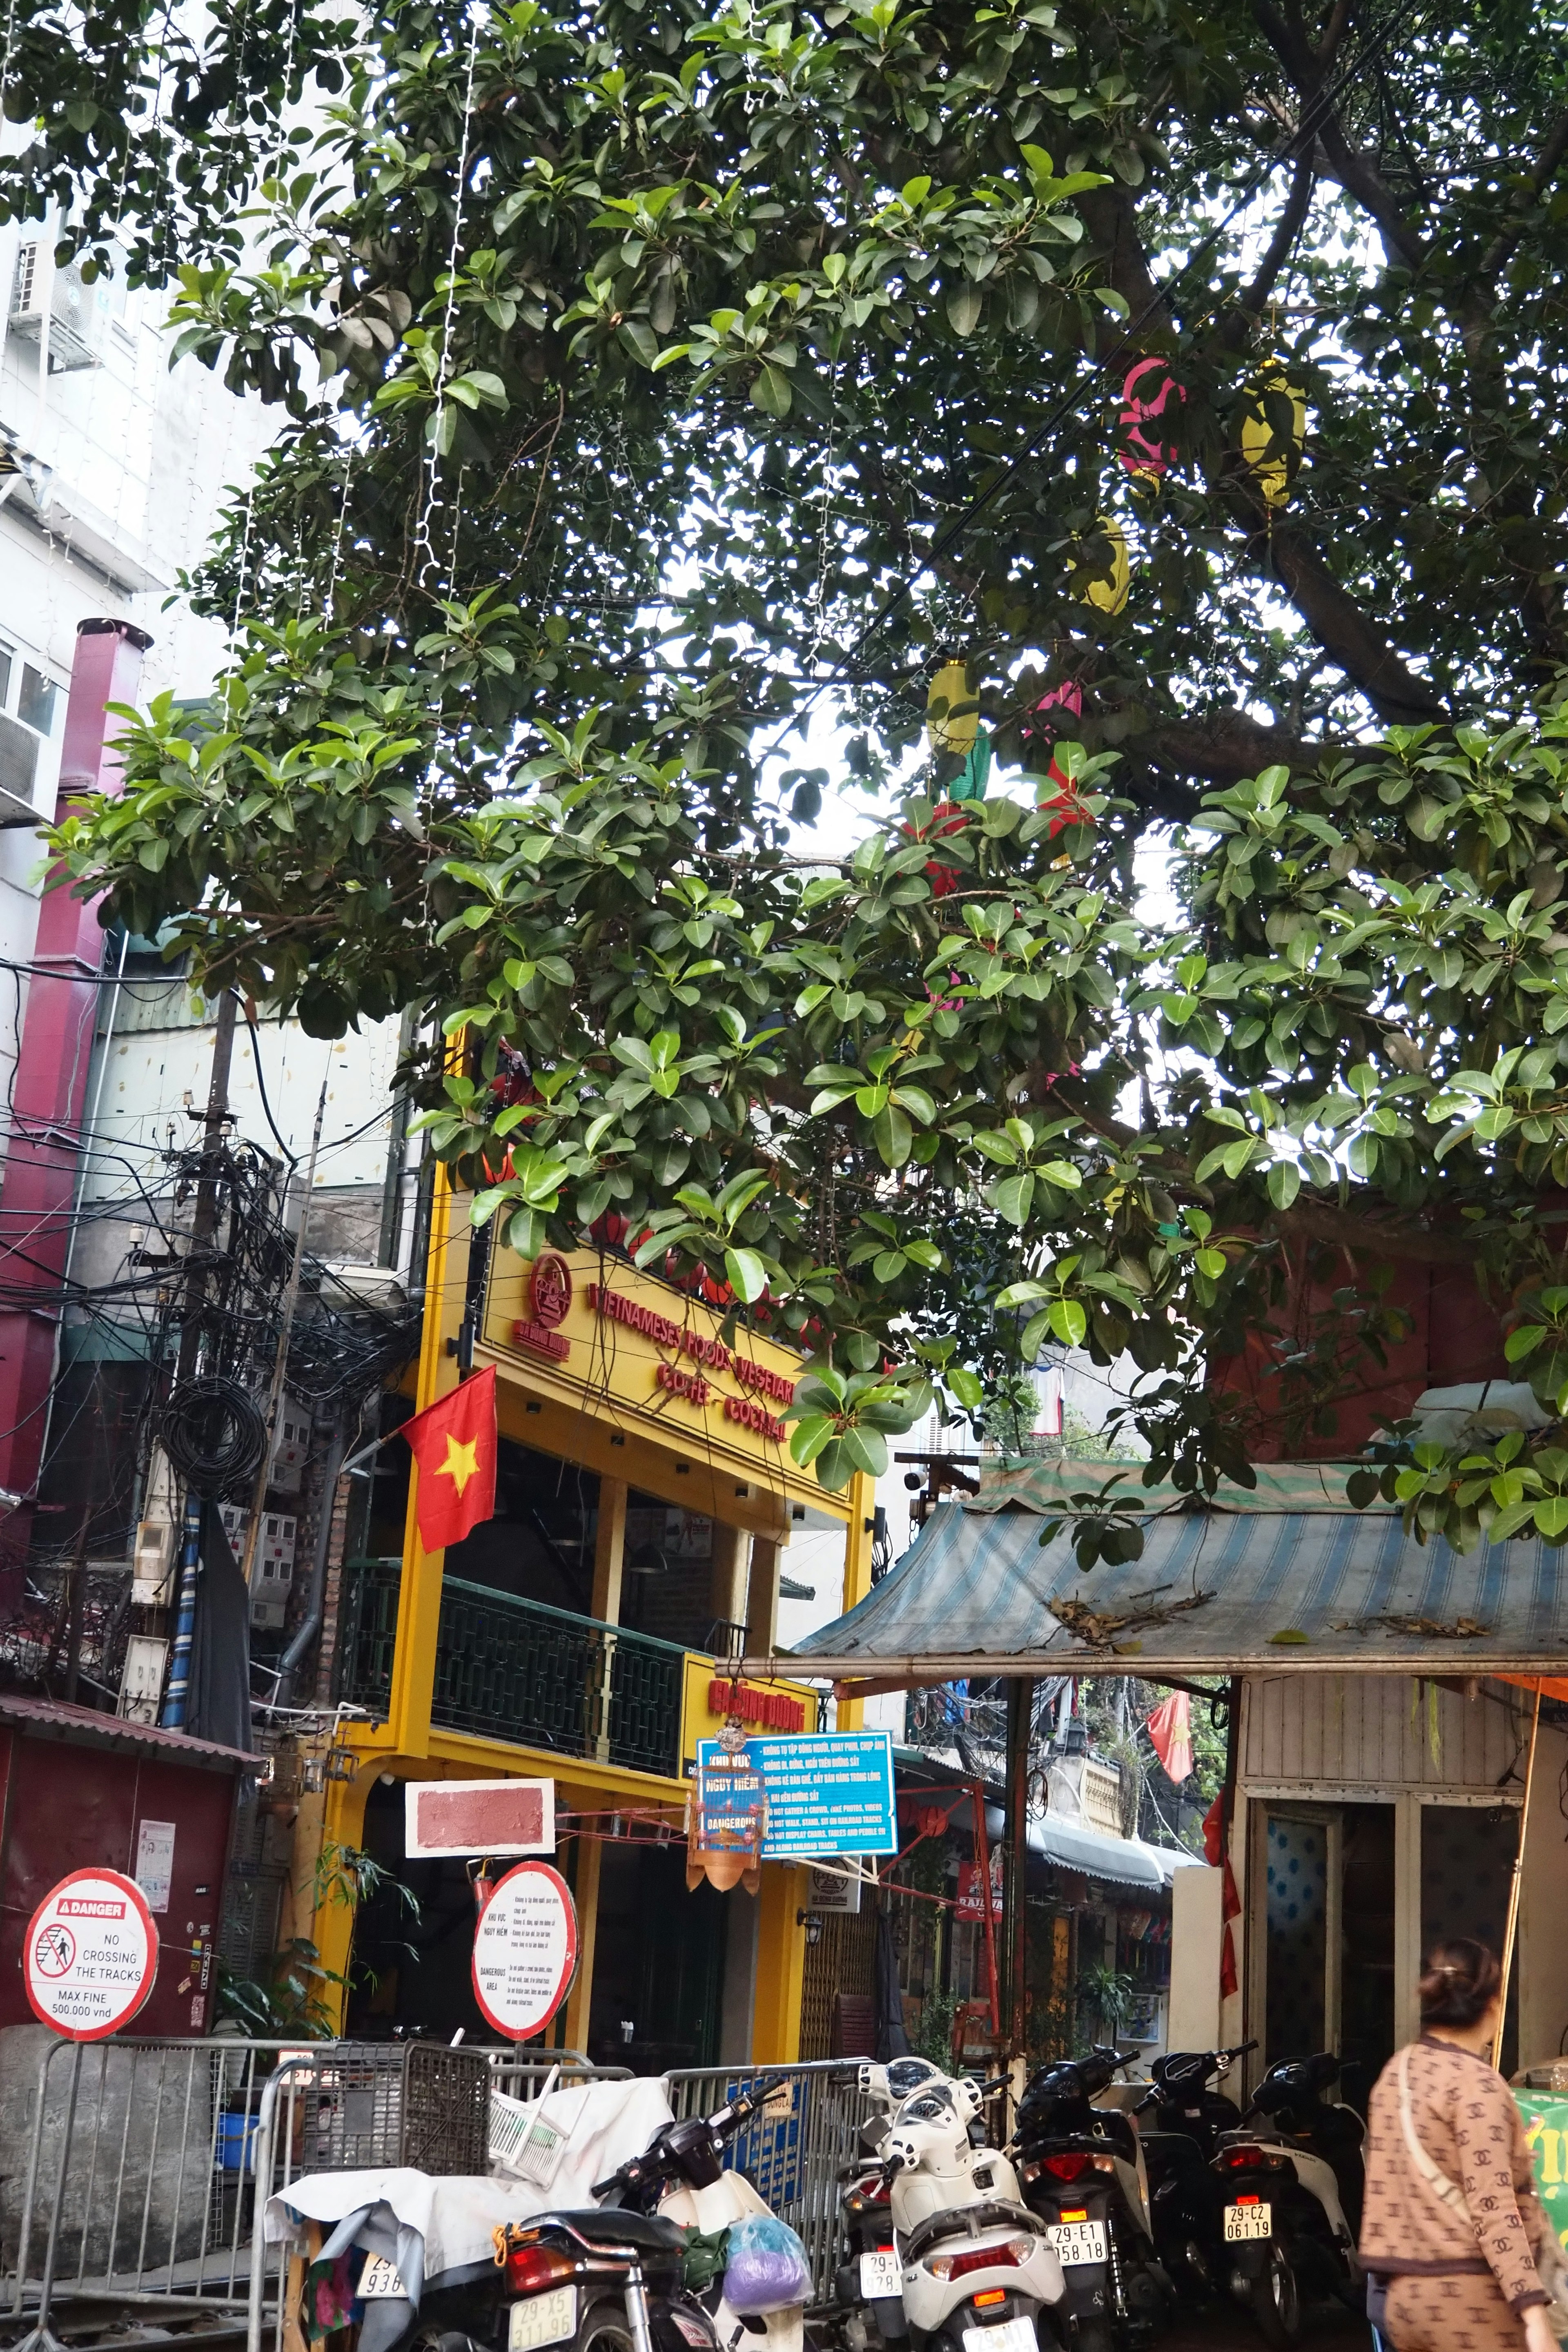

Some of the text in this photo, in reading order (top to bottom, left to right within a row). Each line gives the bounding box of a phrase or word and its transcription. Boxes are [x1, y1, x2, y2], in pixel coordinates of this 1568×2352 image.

[686, 1330, 731, 1370] FOODS
[71, 1902, 122, 1916] DANGER
[105, 1935, 119, 1944] NO
[83, 1950, 136, 1963] CROSSING
[76, 1967, 141, 1981] THE TRACKS
[481, 1967, 506, 1976] DANGEROUS
[58, 1991, 107, 2003] MAX FINE
[53, 2004, 111, 2017] 500.000 vnd
[1231, 2205, 1263, 2222] 29-C2
[1056, 2224, 1094, 2243] 29-E1
[1228, 2221, 1268, 2238] 061.19
[871, 2256, 898, 2272] 29-
[521, 2292, 565, 2324] 29-X5
[514, 2314, 569, 2350] 311.96
[975, 2323, 1022, 2352] 29N1
